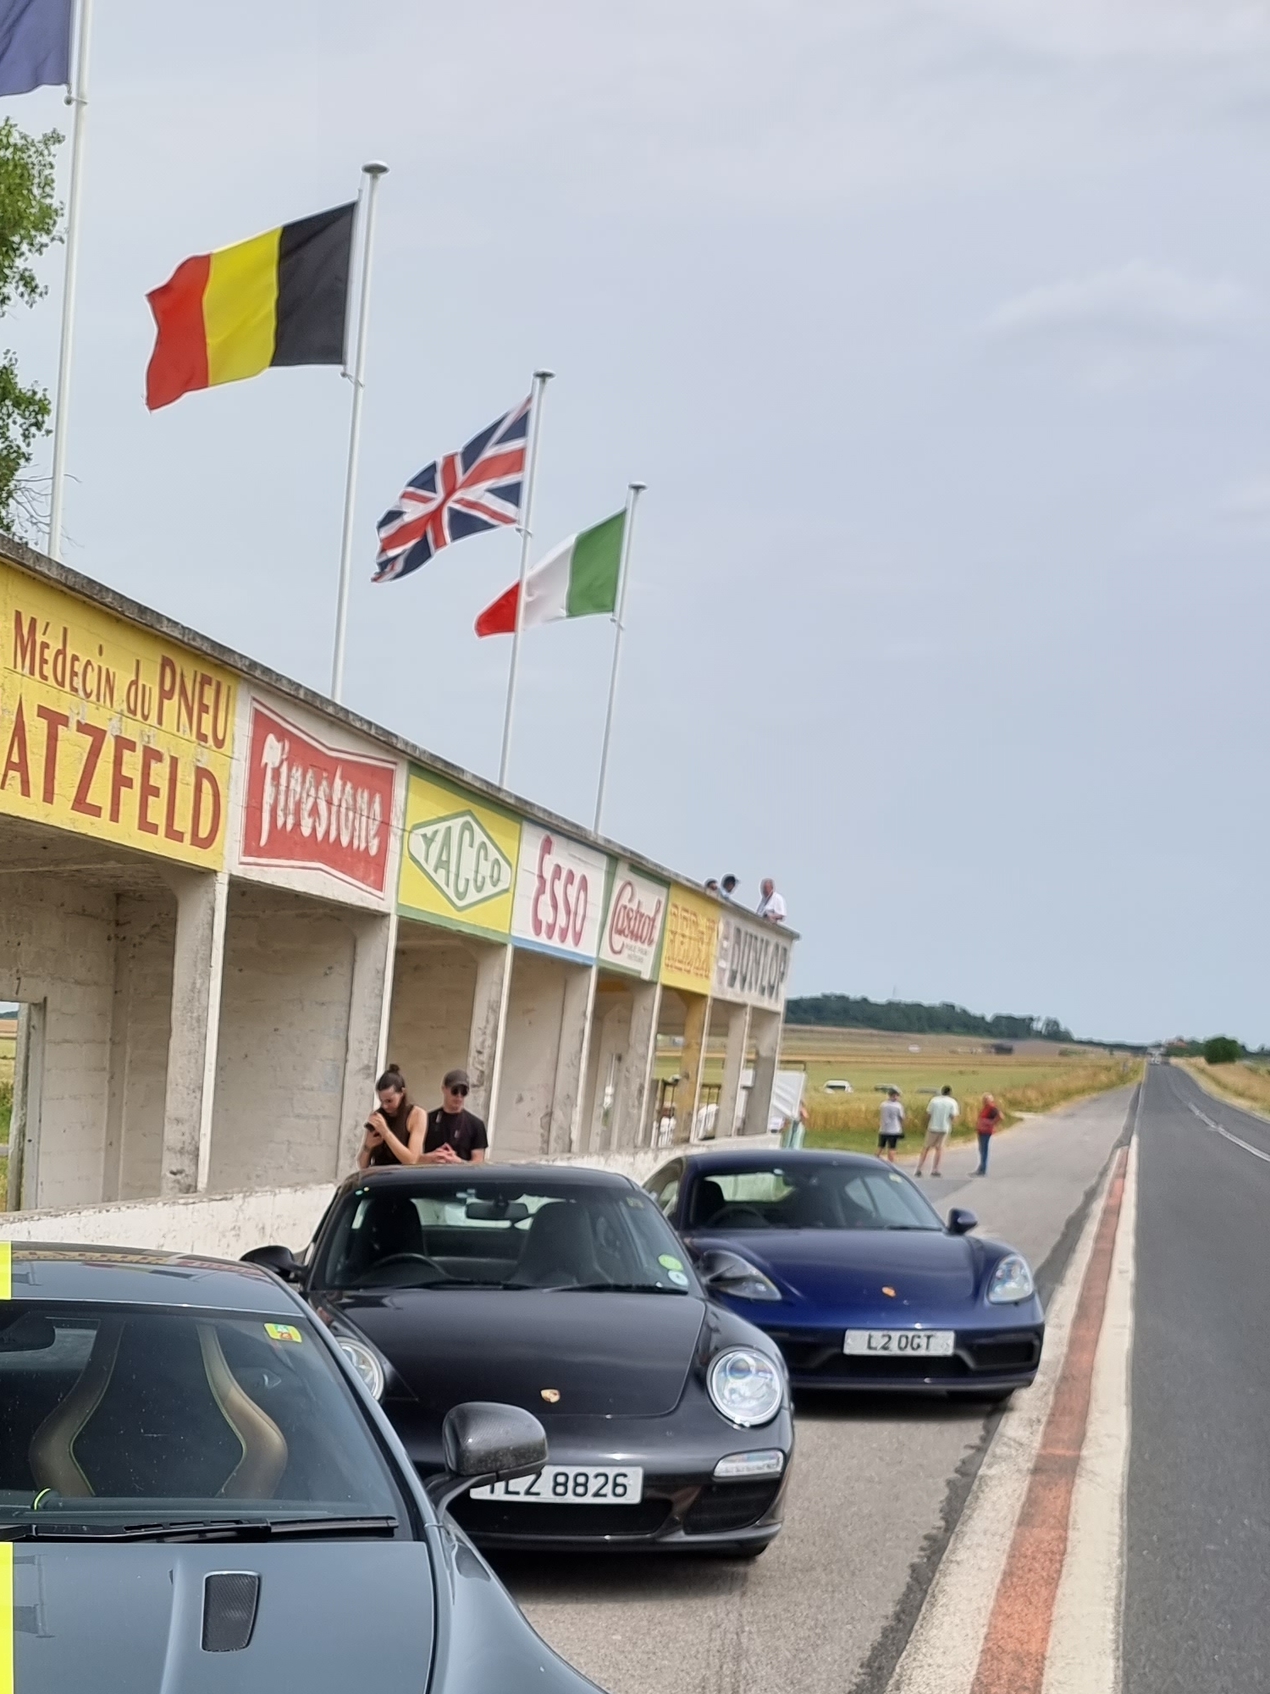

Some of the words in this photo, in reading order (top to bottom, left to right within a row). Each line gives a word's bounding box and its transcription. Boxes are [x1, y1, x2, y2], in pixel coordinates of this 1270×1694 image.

[126, 659, 152, 721] du
[157, 654, 231, 749] PNEU
[260, 733, 381, 856] Firestone
[609, 880, 661, 955] Castrol
[728, 927, 788, 1003] DUNLOP
[552, 1472, 629, 1498] 8826
